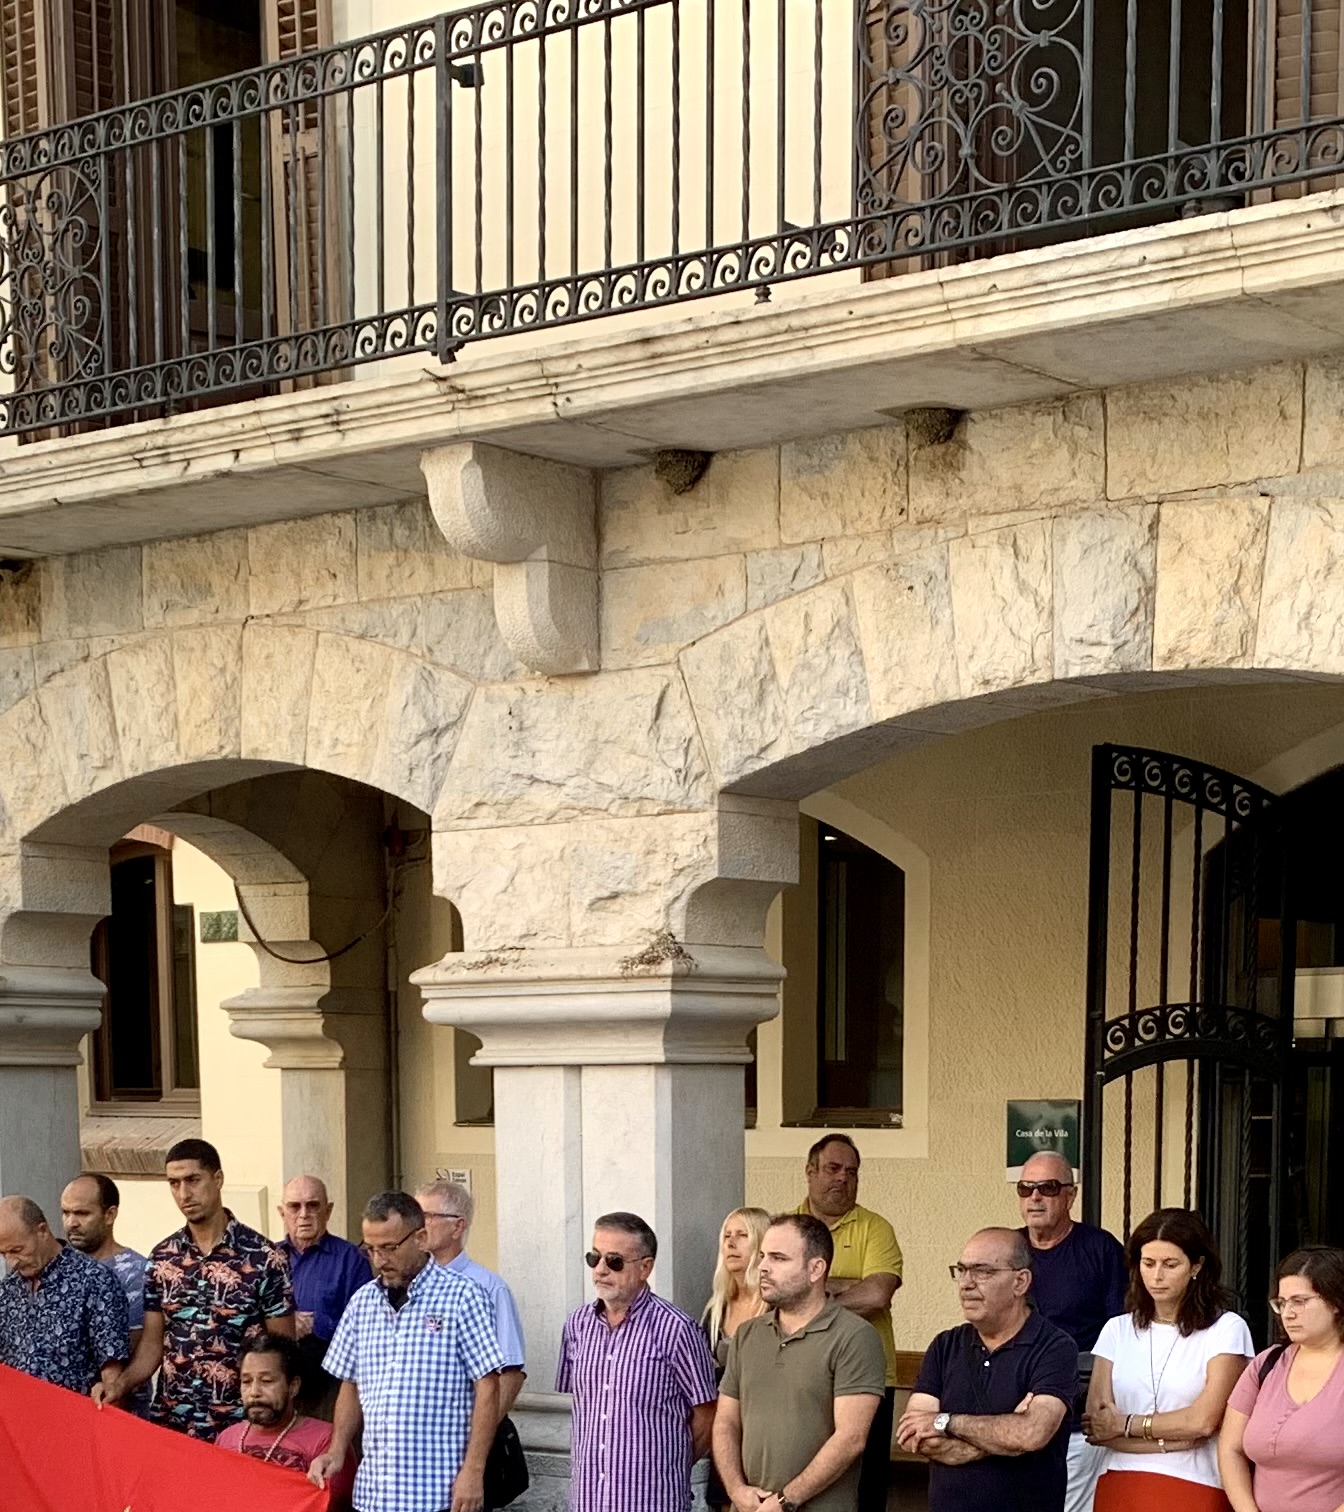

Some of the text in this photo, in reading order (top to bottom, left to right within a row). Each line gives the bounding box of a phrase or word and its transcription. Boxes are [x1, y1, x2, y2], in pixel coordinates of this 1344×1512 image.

[1016, 1128, 1069, 1137] Casa de la Vila
